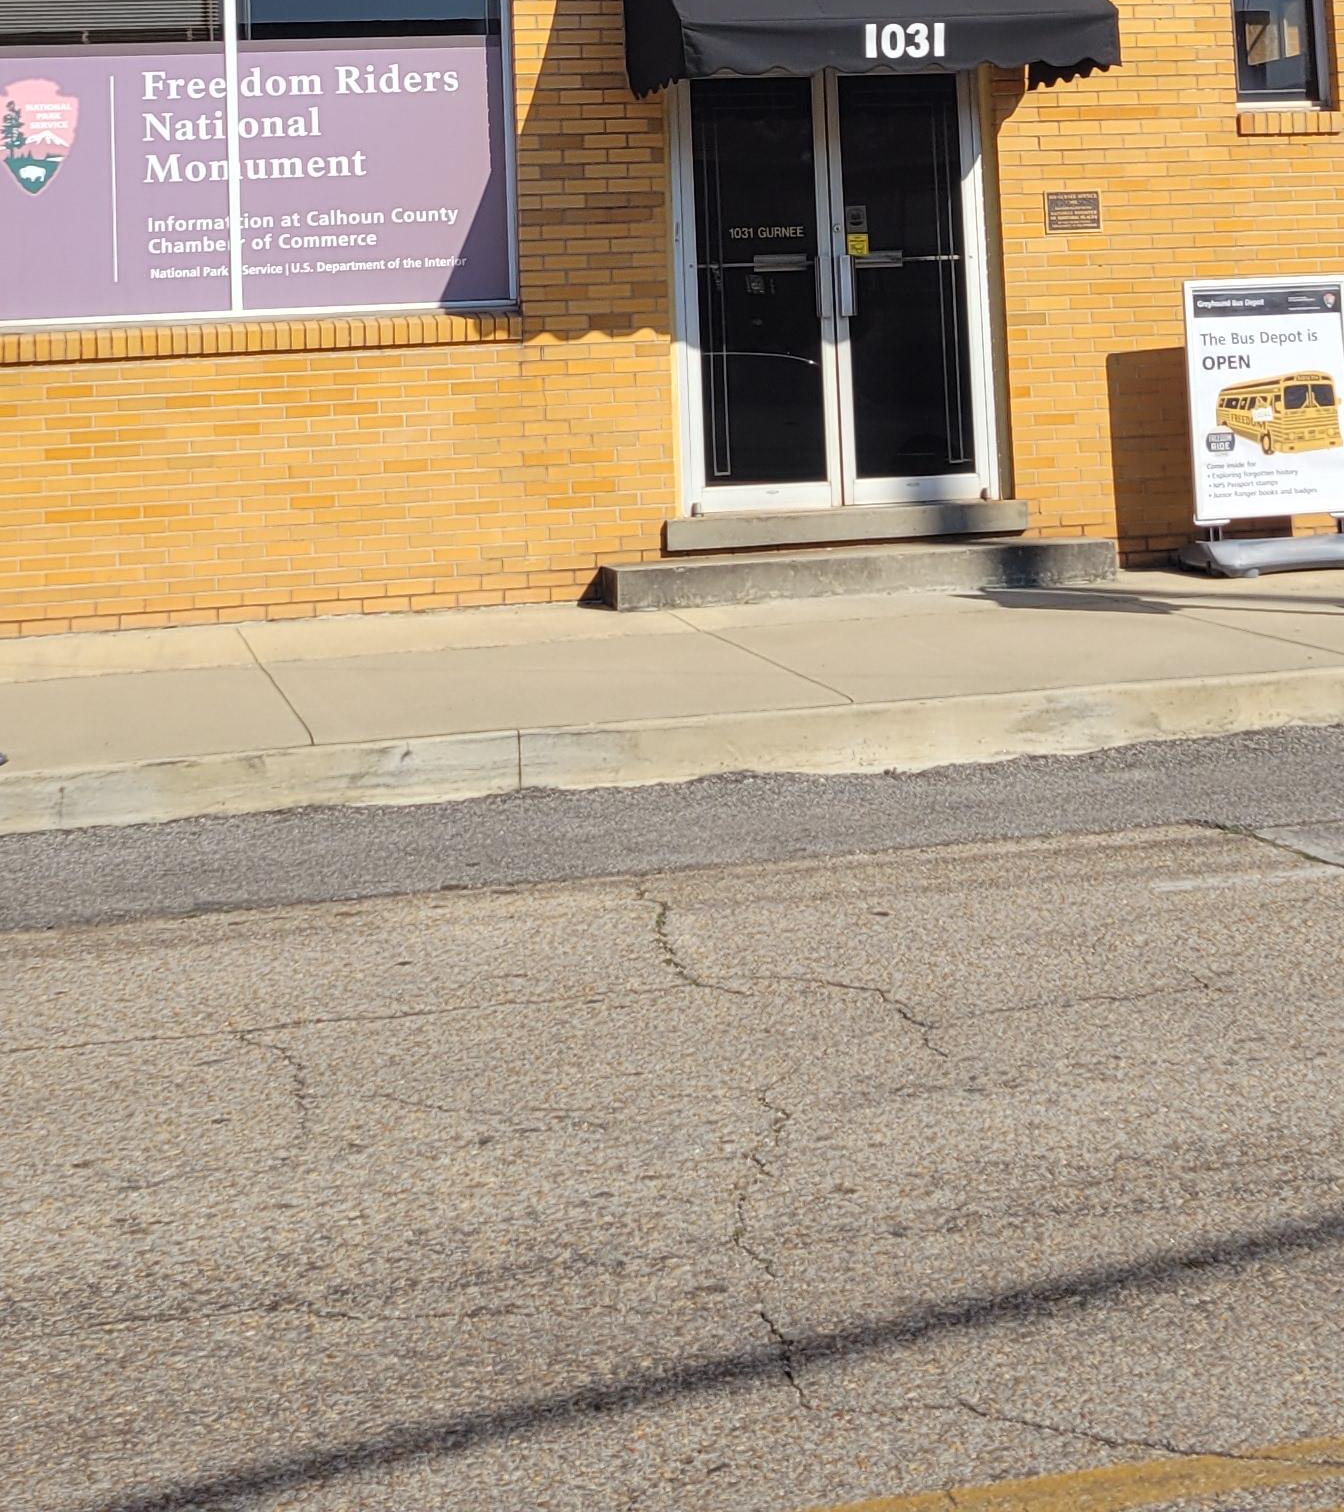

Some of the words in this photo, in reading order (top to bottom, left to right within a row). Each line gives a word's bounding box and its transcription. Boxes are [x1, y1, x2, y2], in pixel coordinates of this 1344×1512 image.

[865, 22, 945, 58] 1031
[141, 67, 323, 100] Freedom
[334, 64, 459, 94] Riders
[142, 107, 321, 141] National
[143, 151, 367, 183] Monument
[281, 213, 300, 227] at
[307, 209, 384, 226] Calhoun
[391, 207, 458, 225] County
[252, 233, 272, 250] of
[278, 233, 376, 249] Commerce
[728, 227, 754, 239] 1031
[757, 226, 805, 238] GURNEE
[150, 266, 200, 279] National
[203, 265, 229, 277] Park
[241, 263, 283, 275] Service
[291, 262, 314, 273] U.S.
[317, 260, 385, 273] Department
[387, 257, 401, 269] of
[403, 257, 421, 268] the
[425, 255, 467, 267] Interior
[1200, 332, 1226, 346] The
[1231, 332, 1255, 345] Bus
[1259, 330, 1303, 346] Depot
[1307, 328, 1318, 342] is
[1202, 354, 1251, 371] OPEN
